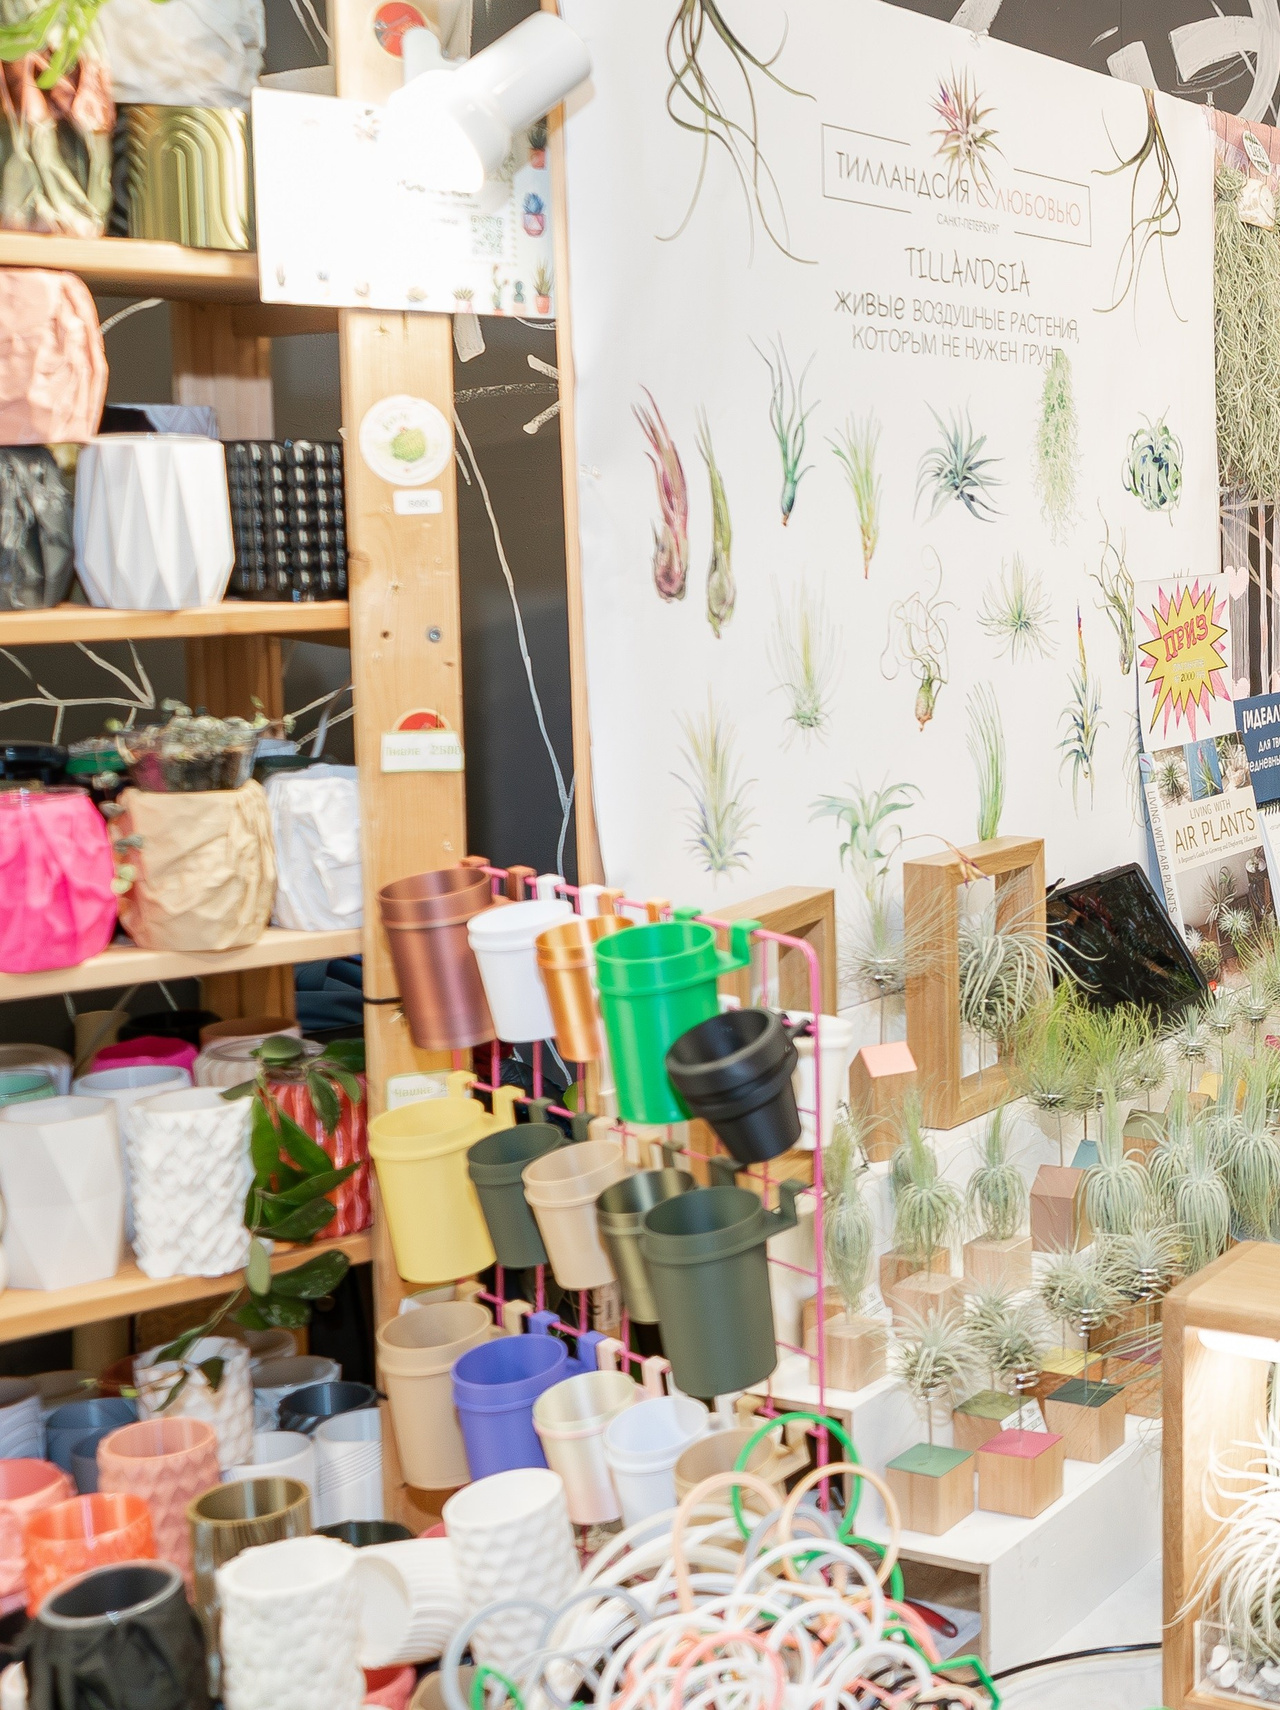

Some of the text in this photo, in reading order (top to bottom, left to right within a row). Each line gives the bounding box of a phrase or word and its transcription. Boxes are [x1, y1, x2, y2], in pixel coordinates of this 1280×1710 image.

[836, 151, 970, 204] ТИЛЛАНДСИЯ
[995, 187, 1082, 227] ЛЮБОВЬЮ
[904, 247, 1030, 297] TILLANDSIA
[913, 298, 1005, 331] ВОЗДУШНЫЕ
[1011, 311, 1080, 344] РАСТЕНИЯ,
[852, 324, 1062, 368] КОТОРЫМ НЕ НУЖЕН ГРУНТ
[1163, 614, 1209, 662] ПРИЗ
[1180, 671, 1196, 682] 2000
[1175, 807, 1256, 854] AIR PLANTS
[1189, 798, 1232, 820] LIVING WITH
[1147, 790, 1177, 914] LIVING WITH AIR PLANTS
